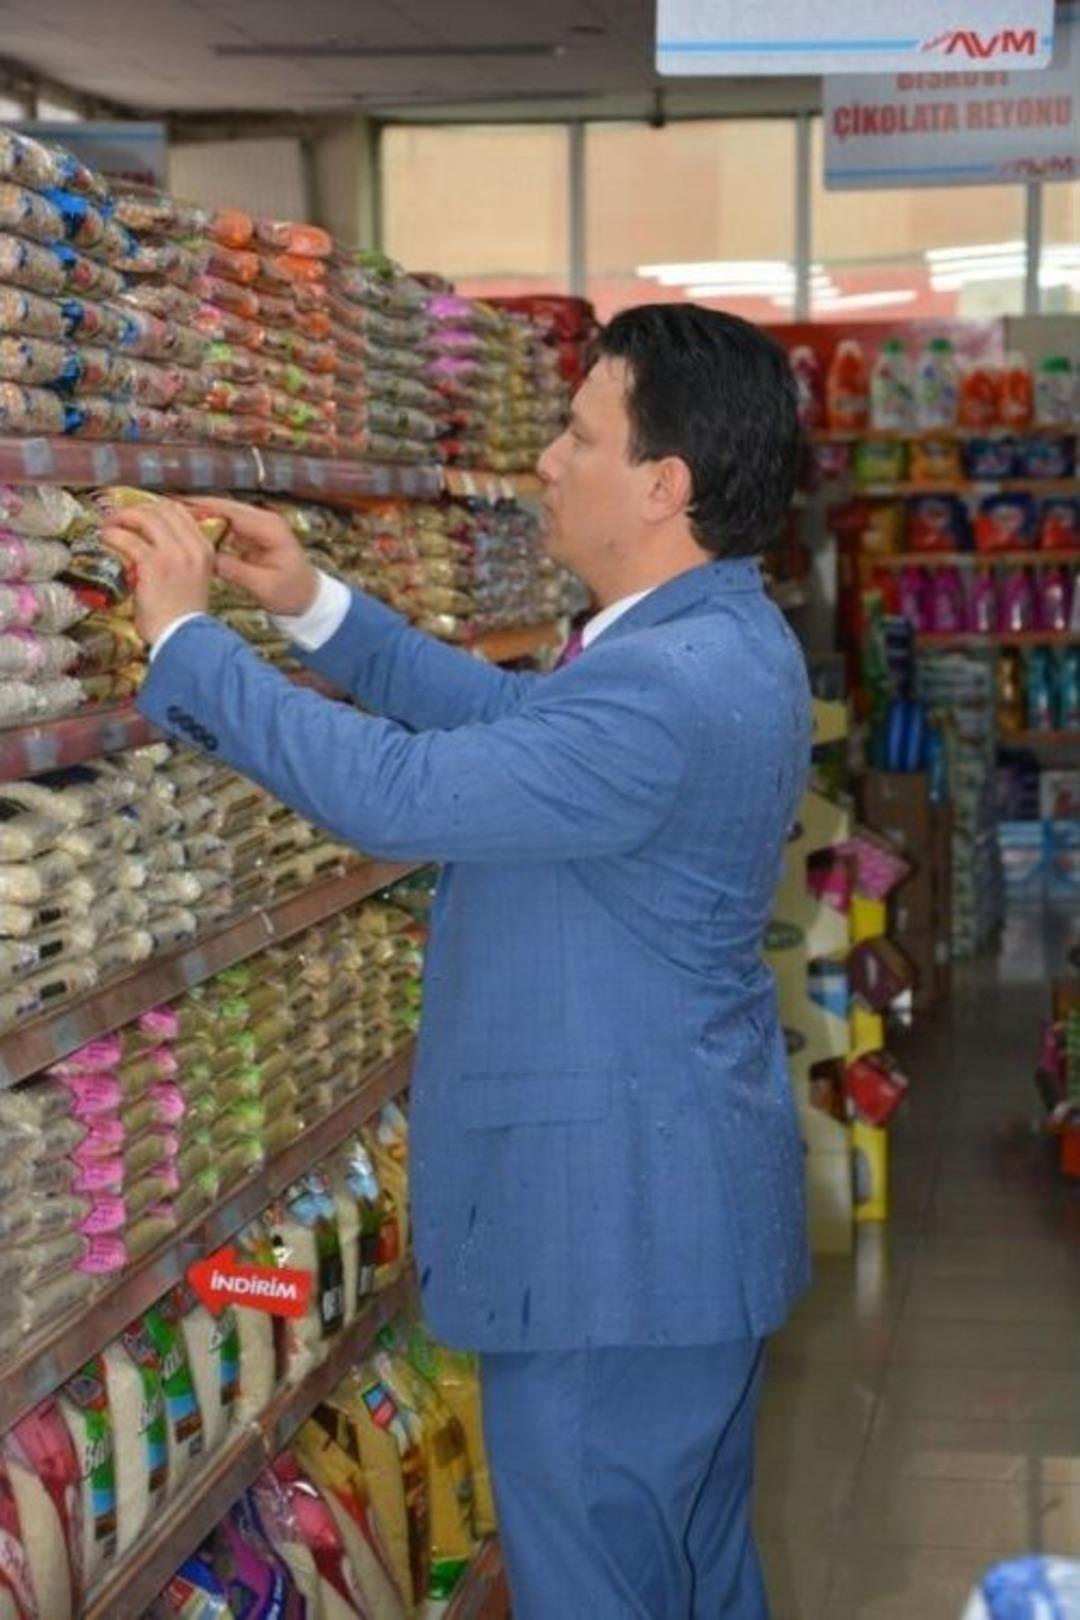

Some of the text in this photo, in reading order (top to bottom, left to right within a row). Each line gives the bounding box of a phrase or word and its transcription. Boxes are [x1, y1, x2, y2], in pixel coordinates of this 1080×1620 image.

[944, 29, 1037, 58] AVM
[832, 96, 1072, 142] ÇİKOLATA REYONU
[210, 1269, 298, 1300] İNDİRİM
